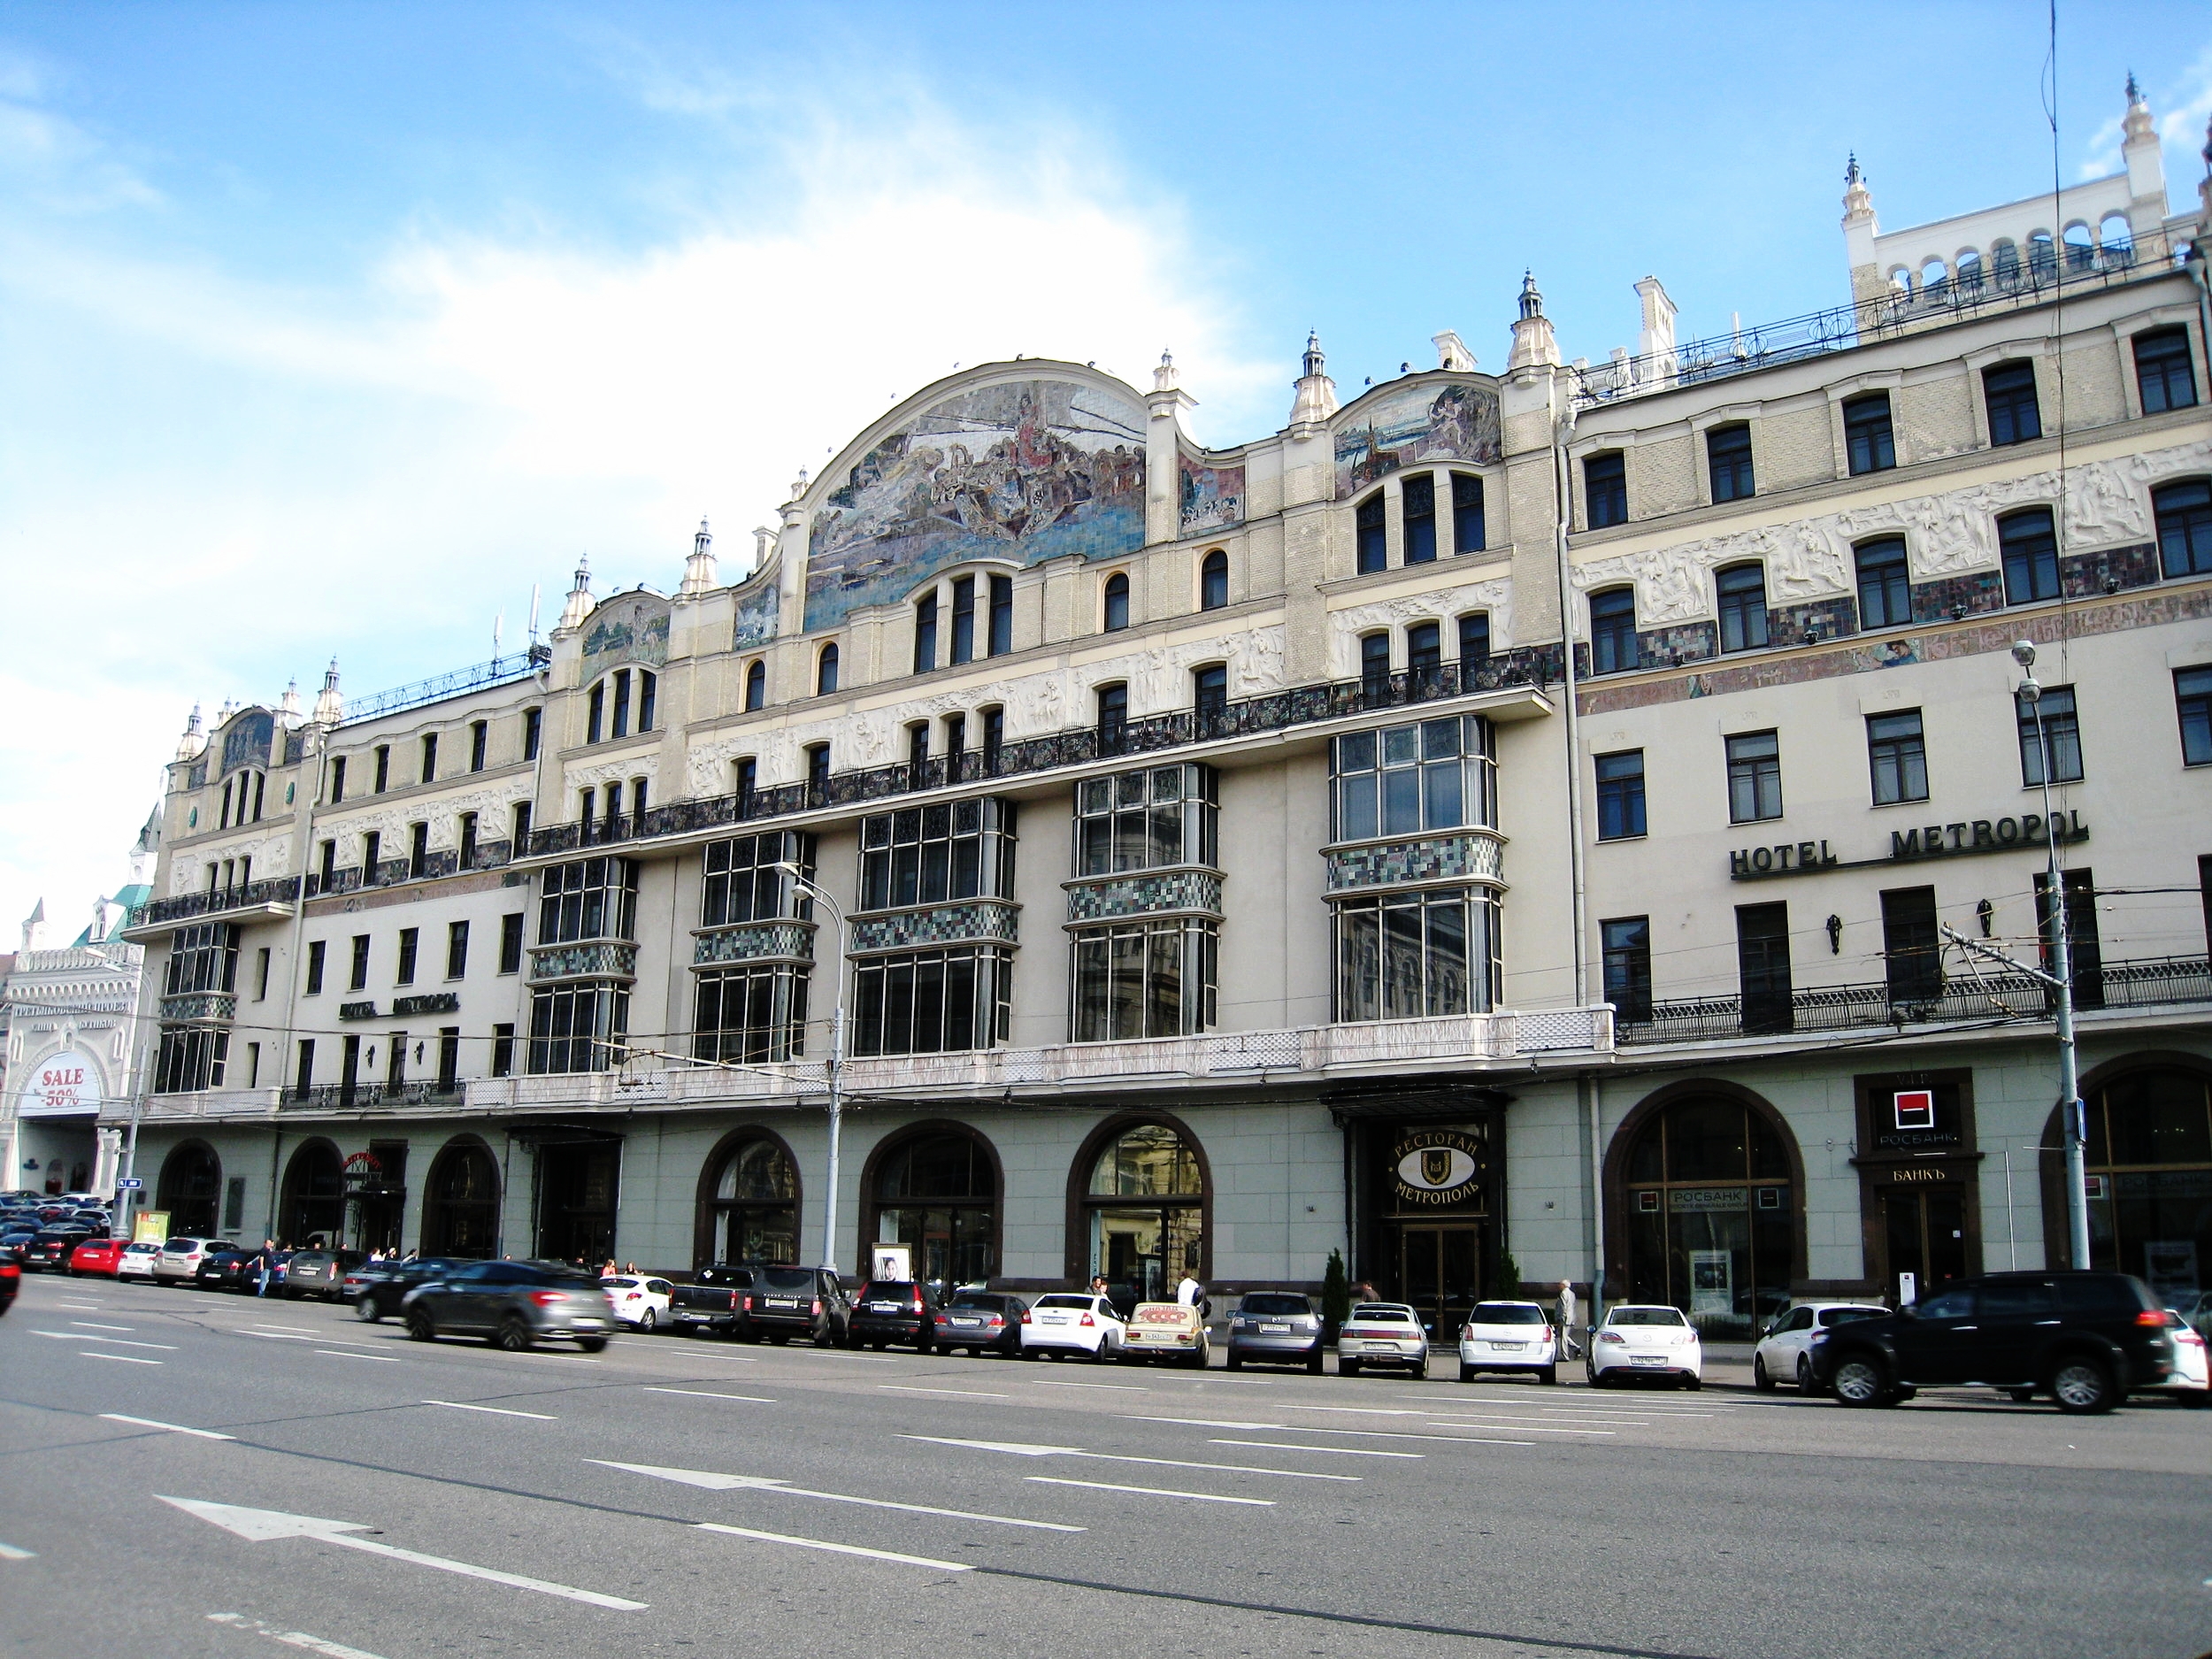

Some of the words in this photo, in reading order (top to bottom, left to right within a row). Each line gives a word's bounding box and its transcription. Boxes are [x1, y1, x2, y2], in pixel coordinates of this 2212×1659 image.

[1730, 839, 1837, 875] HOTEL
[1891, 809, 2089, 855] METROPOL
[42, 1069, 84, 1087] SALE
[41, 1088, 81, 1106] -50%
[1394, 1133, 1478, 1158] РЕСТОРАН
[1880, 1133, 1953, 1146] РОСБАНК
[1893, 1169, 1945, 1181] БАНКЪ
[1395, 1181, 1479, 1204] МЕТРОПОЛЬ
[1674, 1191, 1741, 1203] РОСБАНК
[1147, 1311, 1187, 1325] СССР
